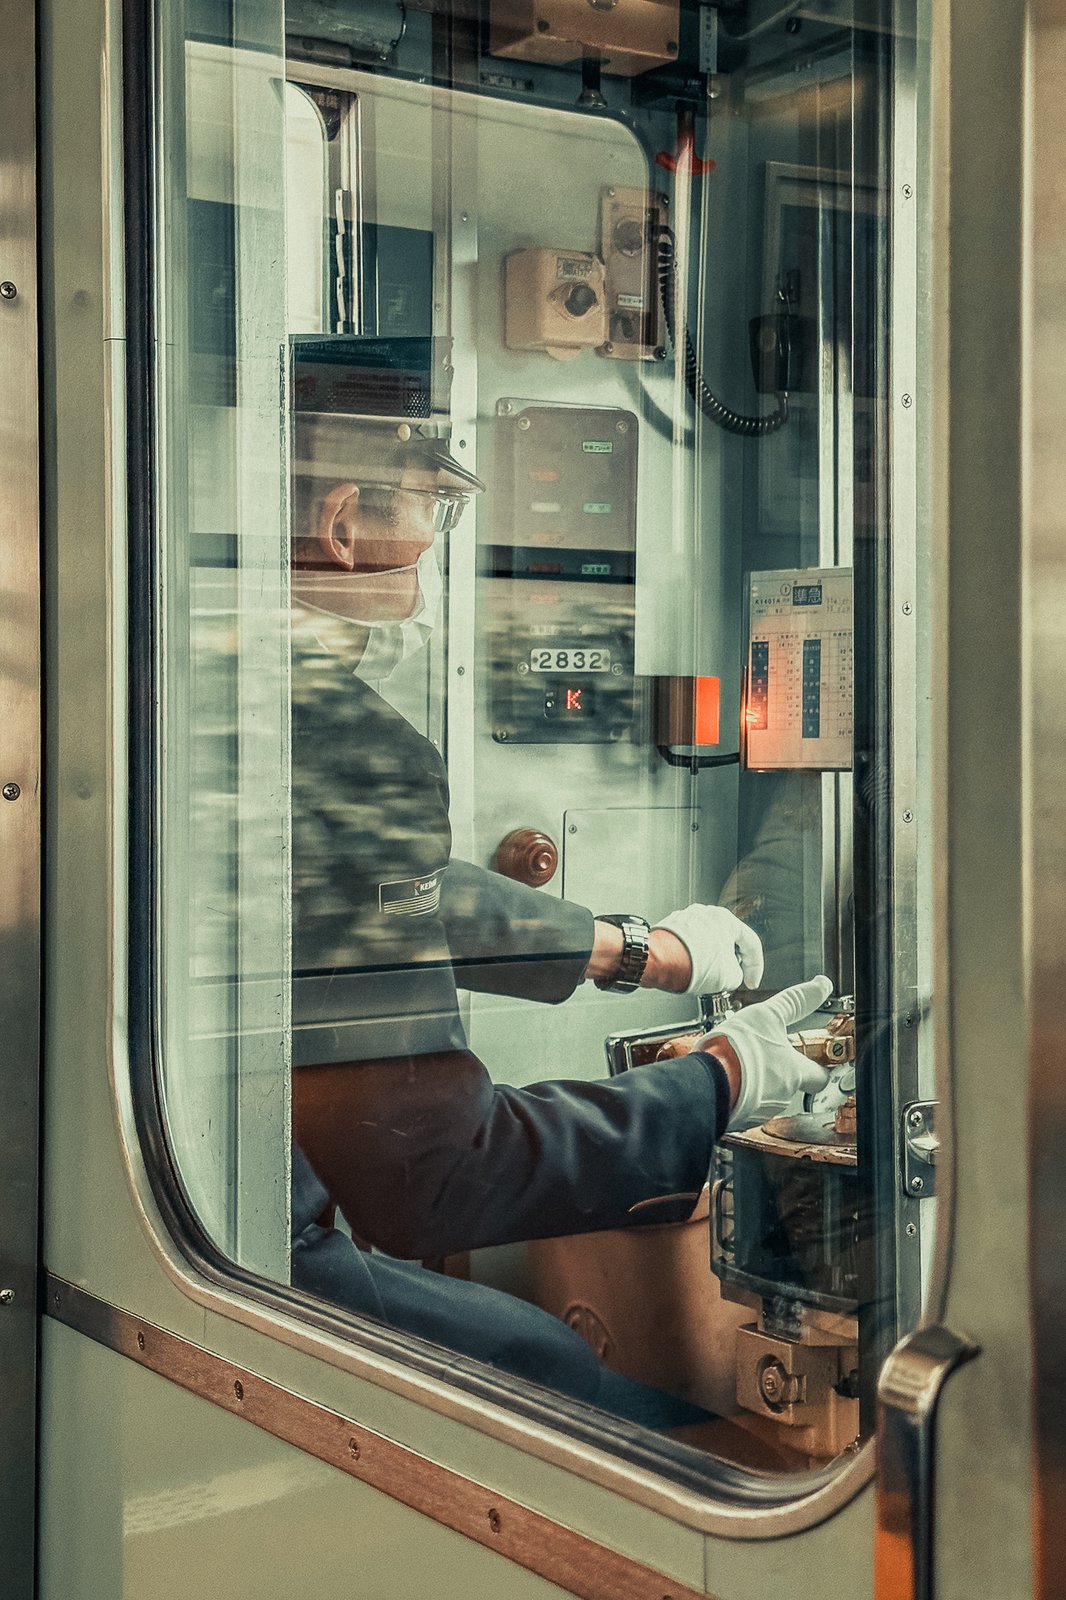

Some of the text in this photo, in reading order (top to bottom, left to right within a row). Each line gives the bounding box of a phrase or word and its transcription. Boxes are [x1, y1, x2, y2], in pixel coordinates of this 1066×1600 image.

[793, 586, 822, 605] 準急
[539, 651, 602, 670] 2832
[566, 688, 582, 710] K
